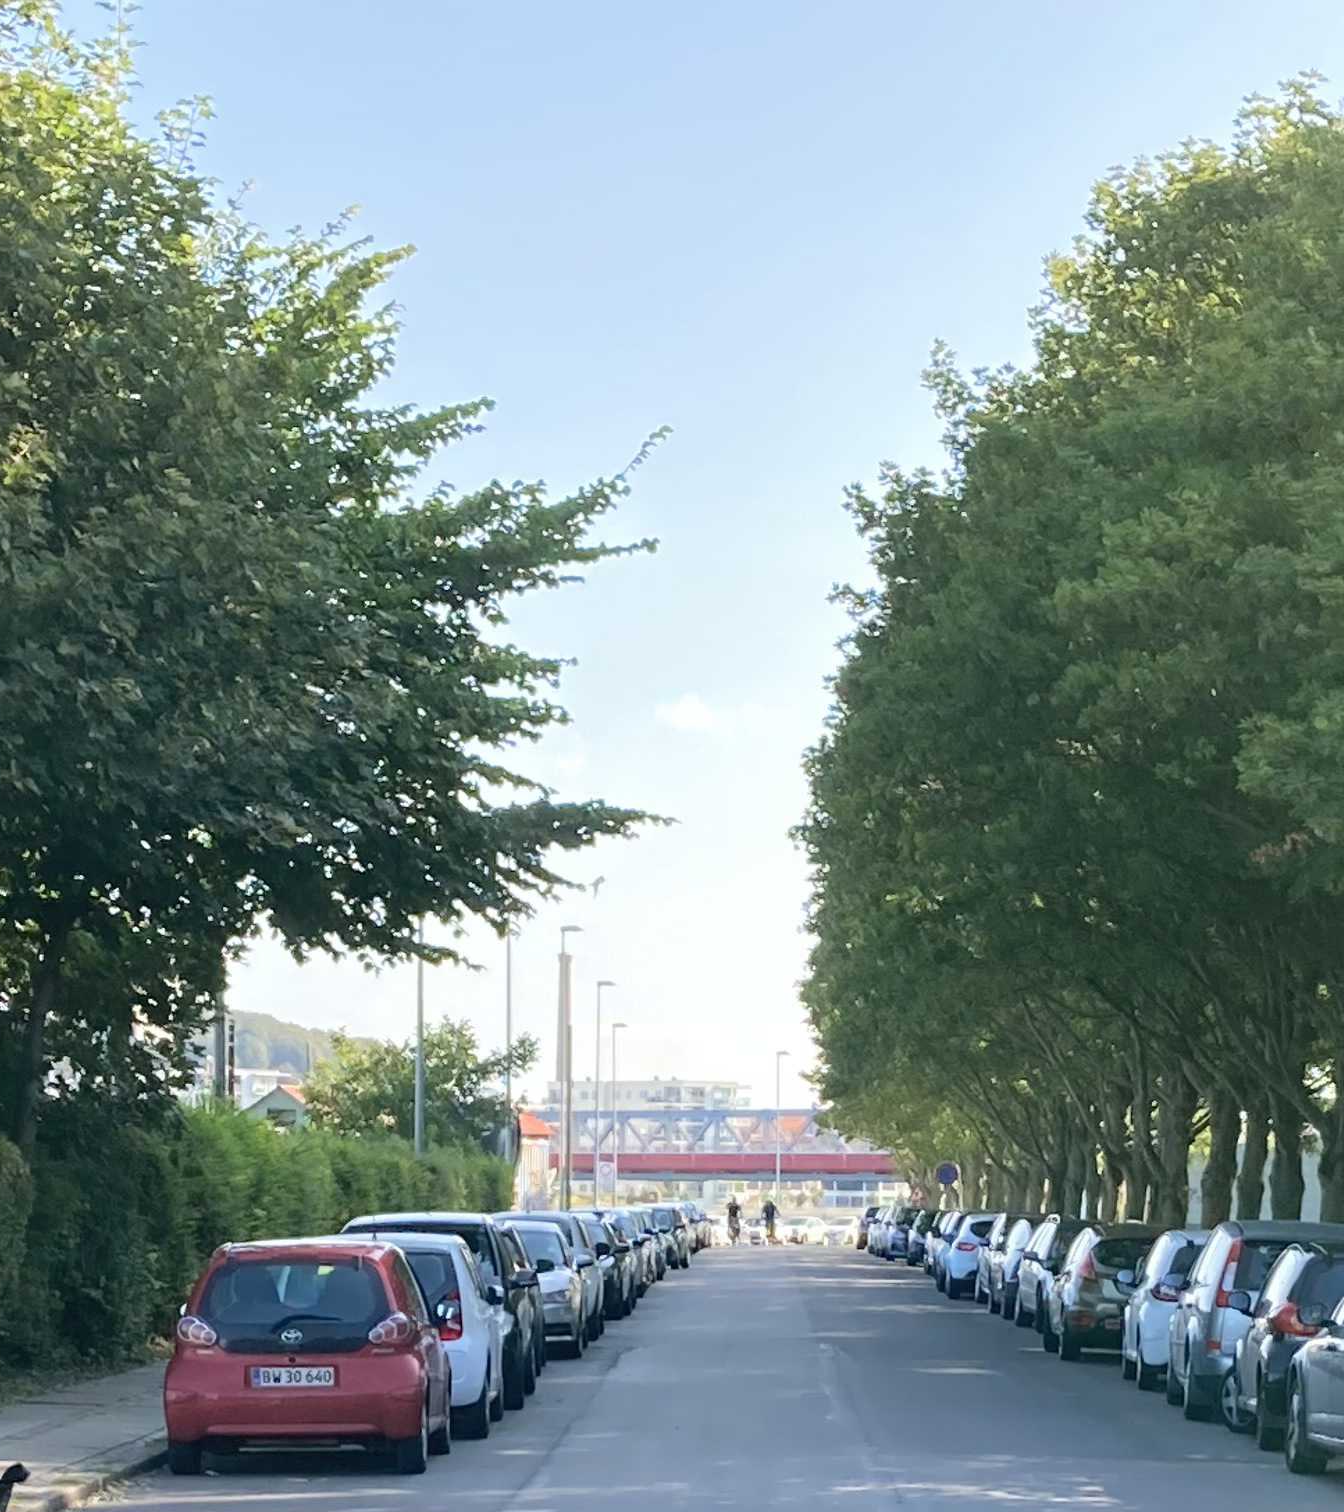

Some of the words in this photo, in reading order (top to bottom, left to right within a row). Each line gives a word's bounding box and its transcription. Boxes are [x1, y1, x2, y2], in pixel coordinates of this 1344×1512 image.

[262, 1370, 282, 1383] BW
[285, 1370, 302, 1383] 30
[305, 1370, 332, 1383] 640
